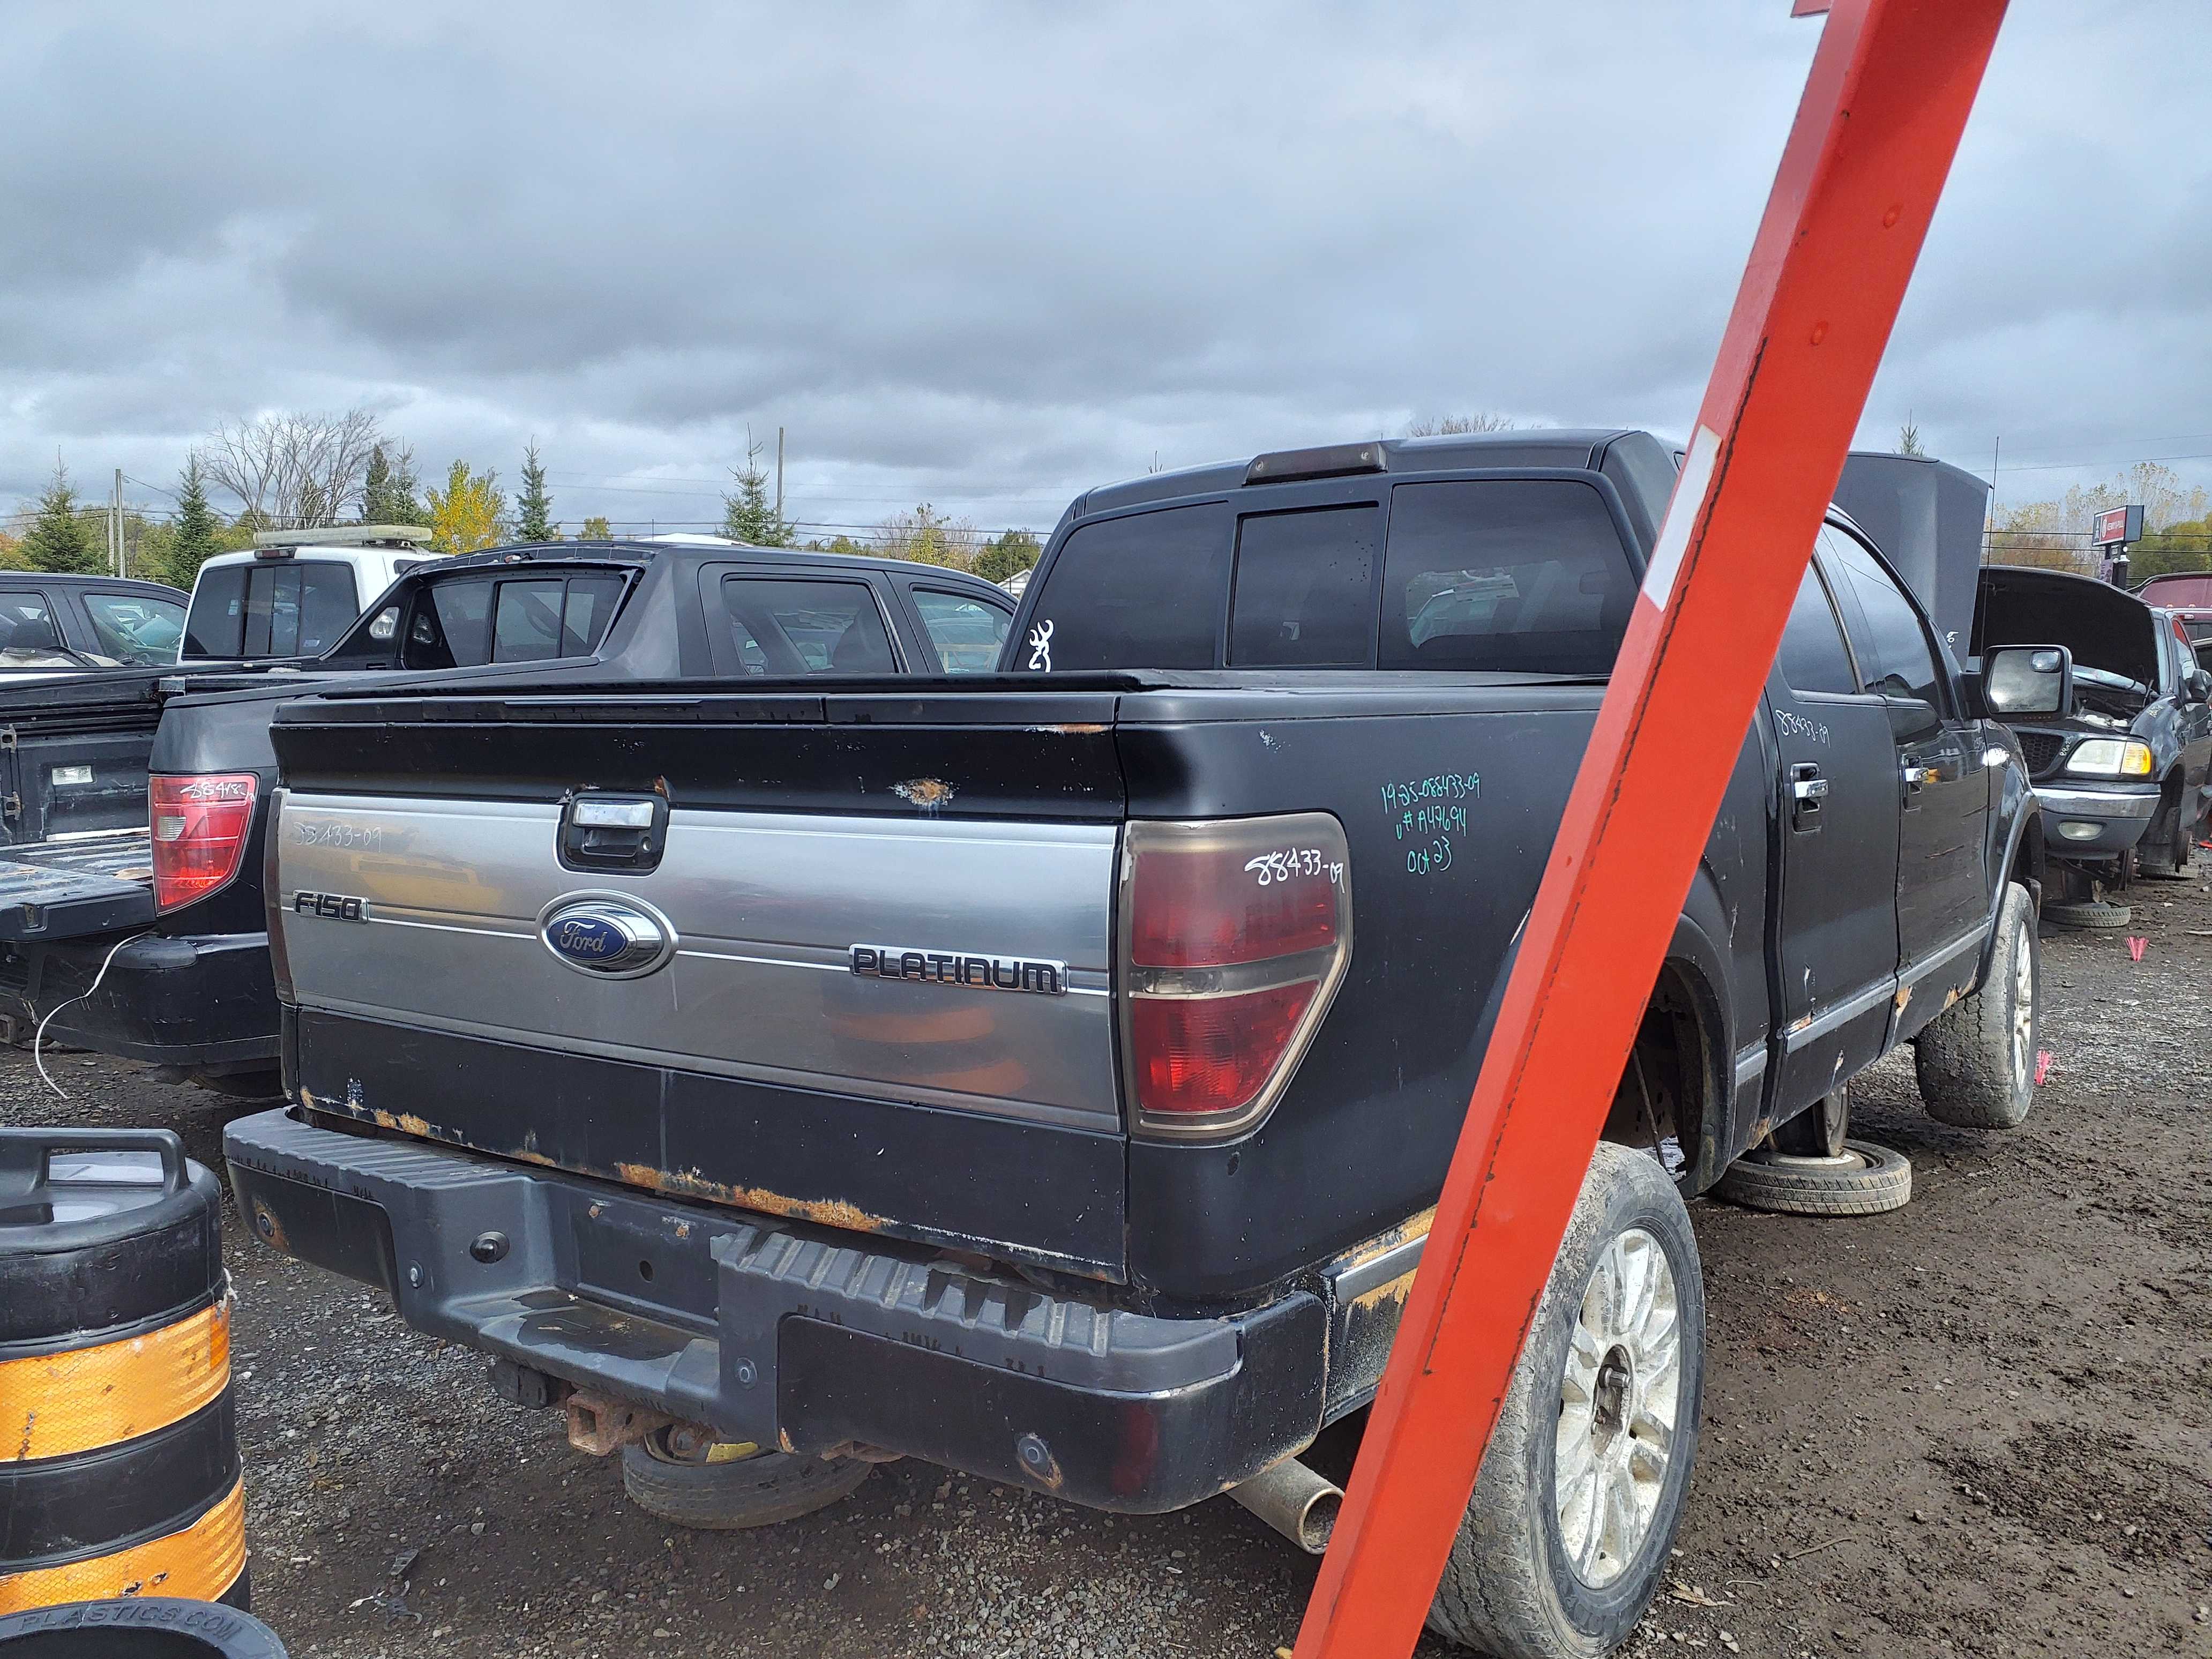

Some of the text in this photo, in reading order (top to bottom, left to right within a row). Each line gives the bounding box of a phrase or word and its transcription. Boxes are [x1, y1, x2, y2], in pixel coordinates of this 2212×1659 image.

[1244, 847, 1346, 894] 88433-09
[1432, 835, 1452, 871] 23
[559, 920, 609, 953] Ford
[853, 947, 1059, 995] PLATINUM
